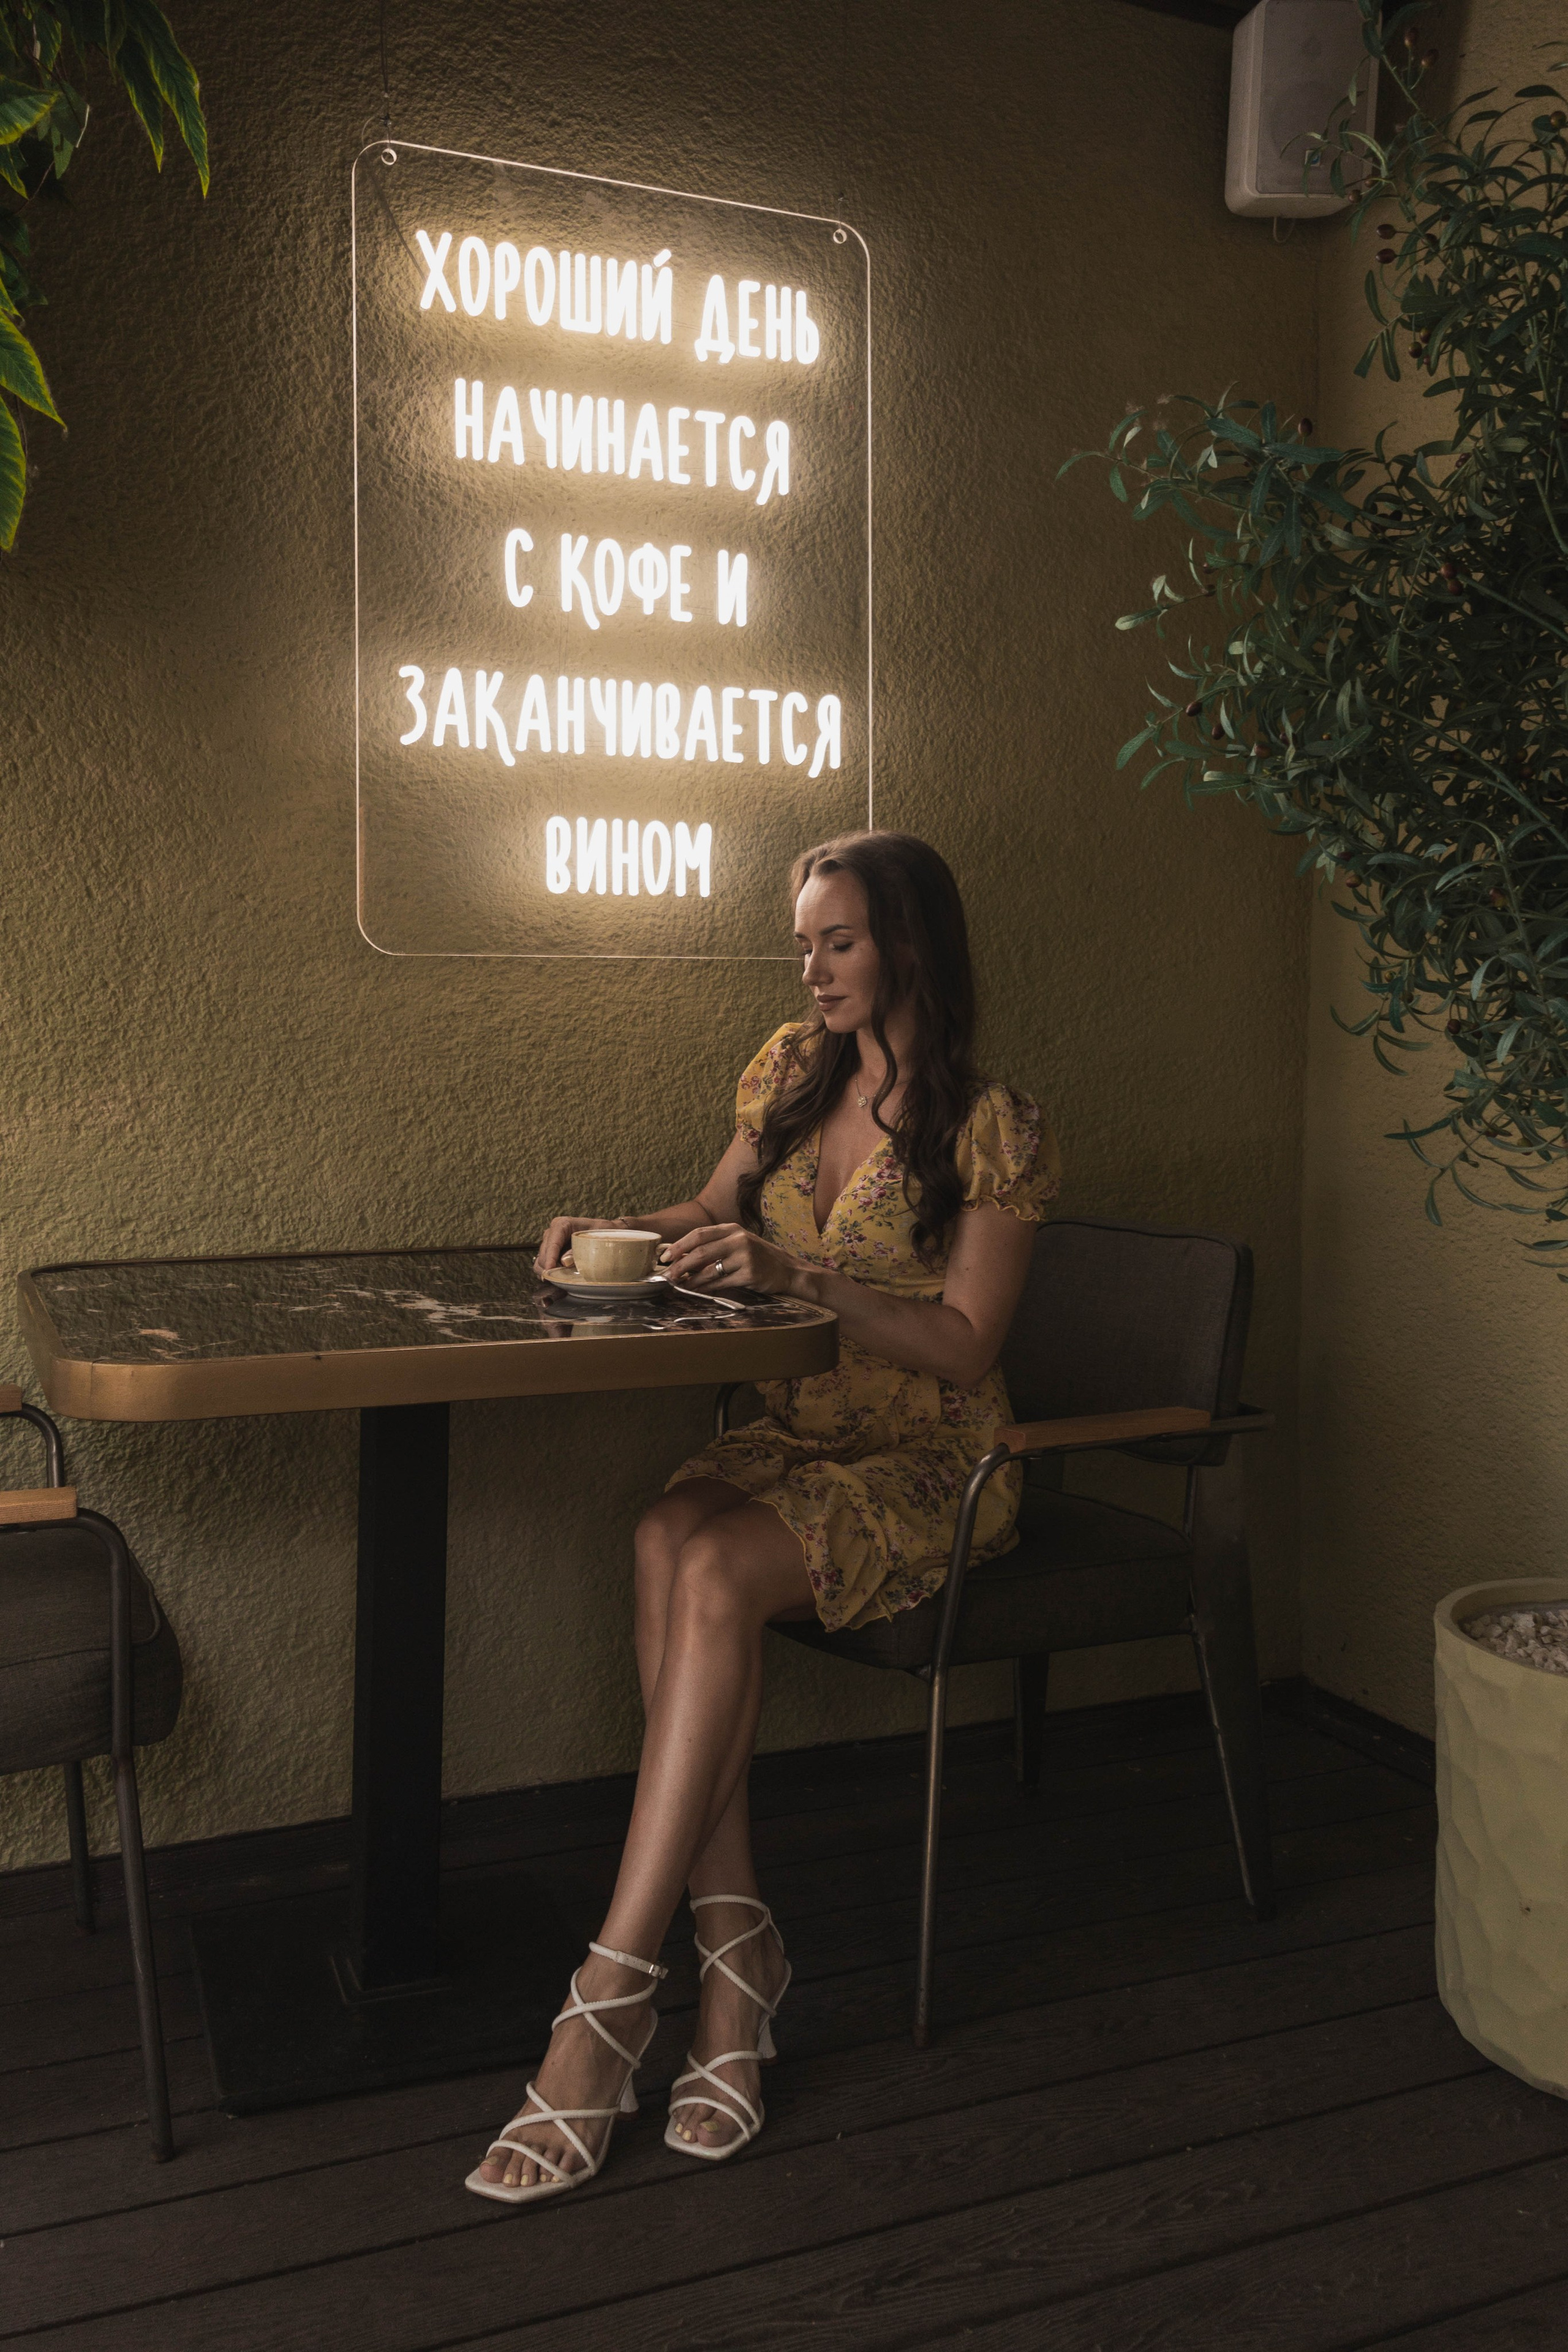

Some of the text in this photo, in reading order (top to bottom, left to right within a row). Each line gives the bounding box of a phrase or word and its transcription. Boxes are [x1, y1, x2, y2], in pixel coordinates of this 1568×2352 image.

[417, 230, 820, 364] ХОРОШИЙ ДЕНЬ
[454, 378, 790, 505] НАЧИНАЕТСЯ
[505, 528, 747, 630] С КОФЕ И
[399, 665, 841, 778] ЗАКАНЧИВАЕТСЯ
[546, 816, 712, 897] ВИНОМ
